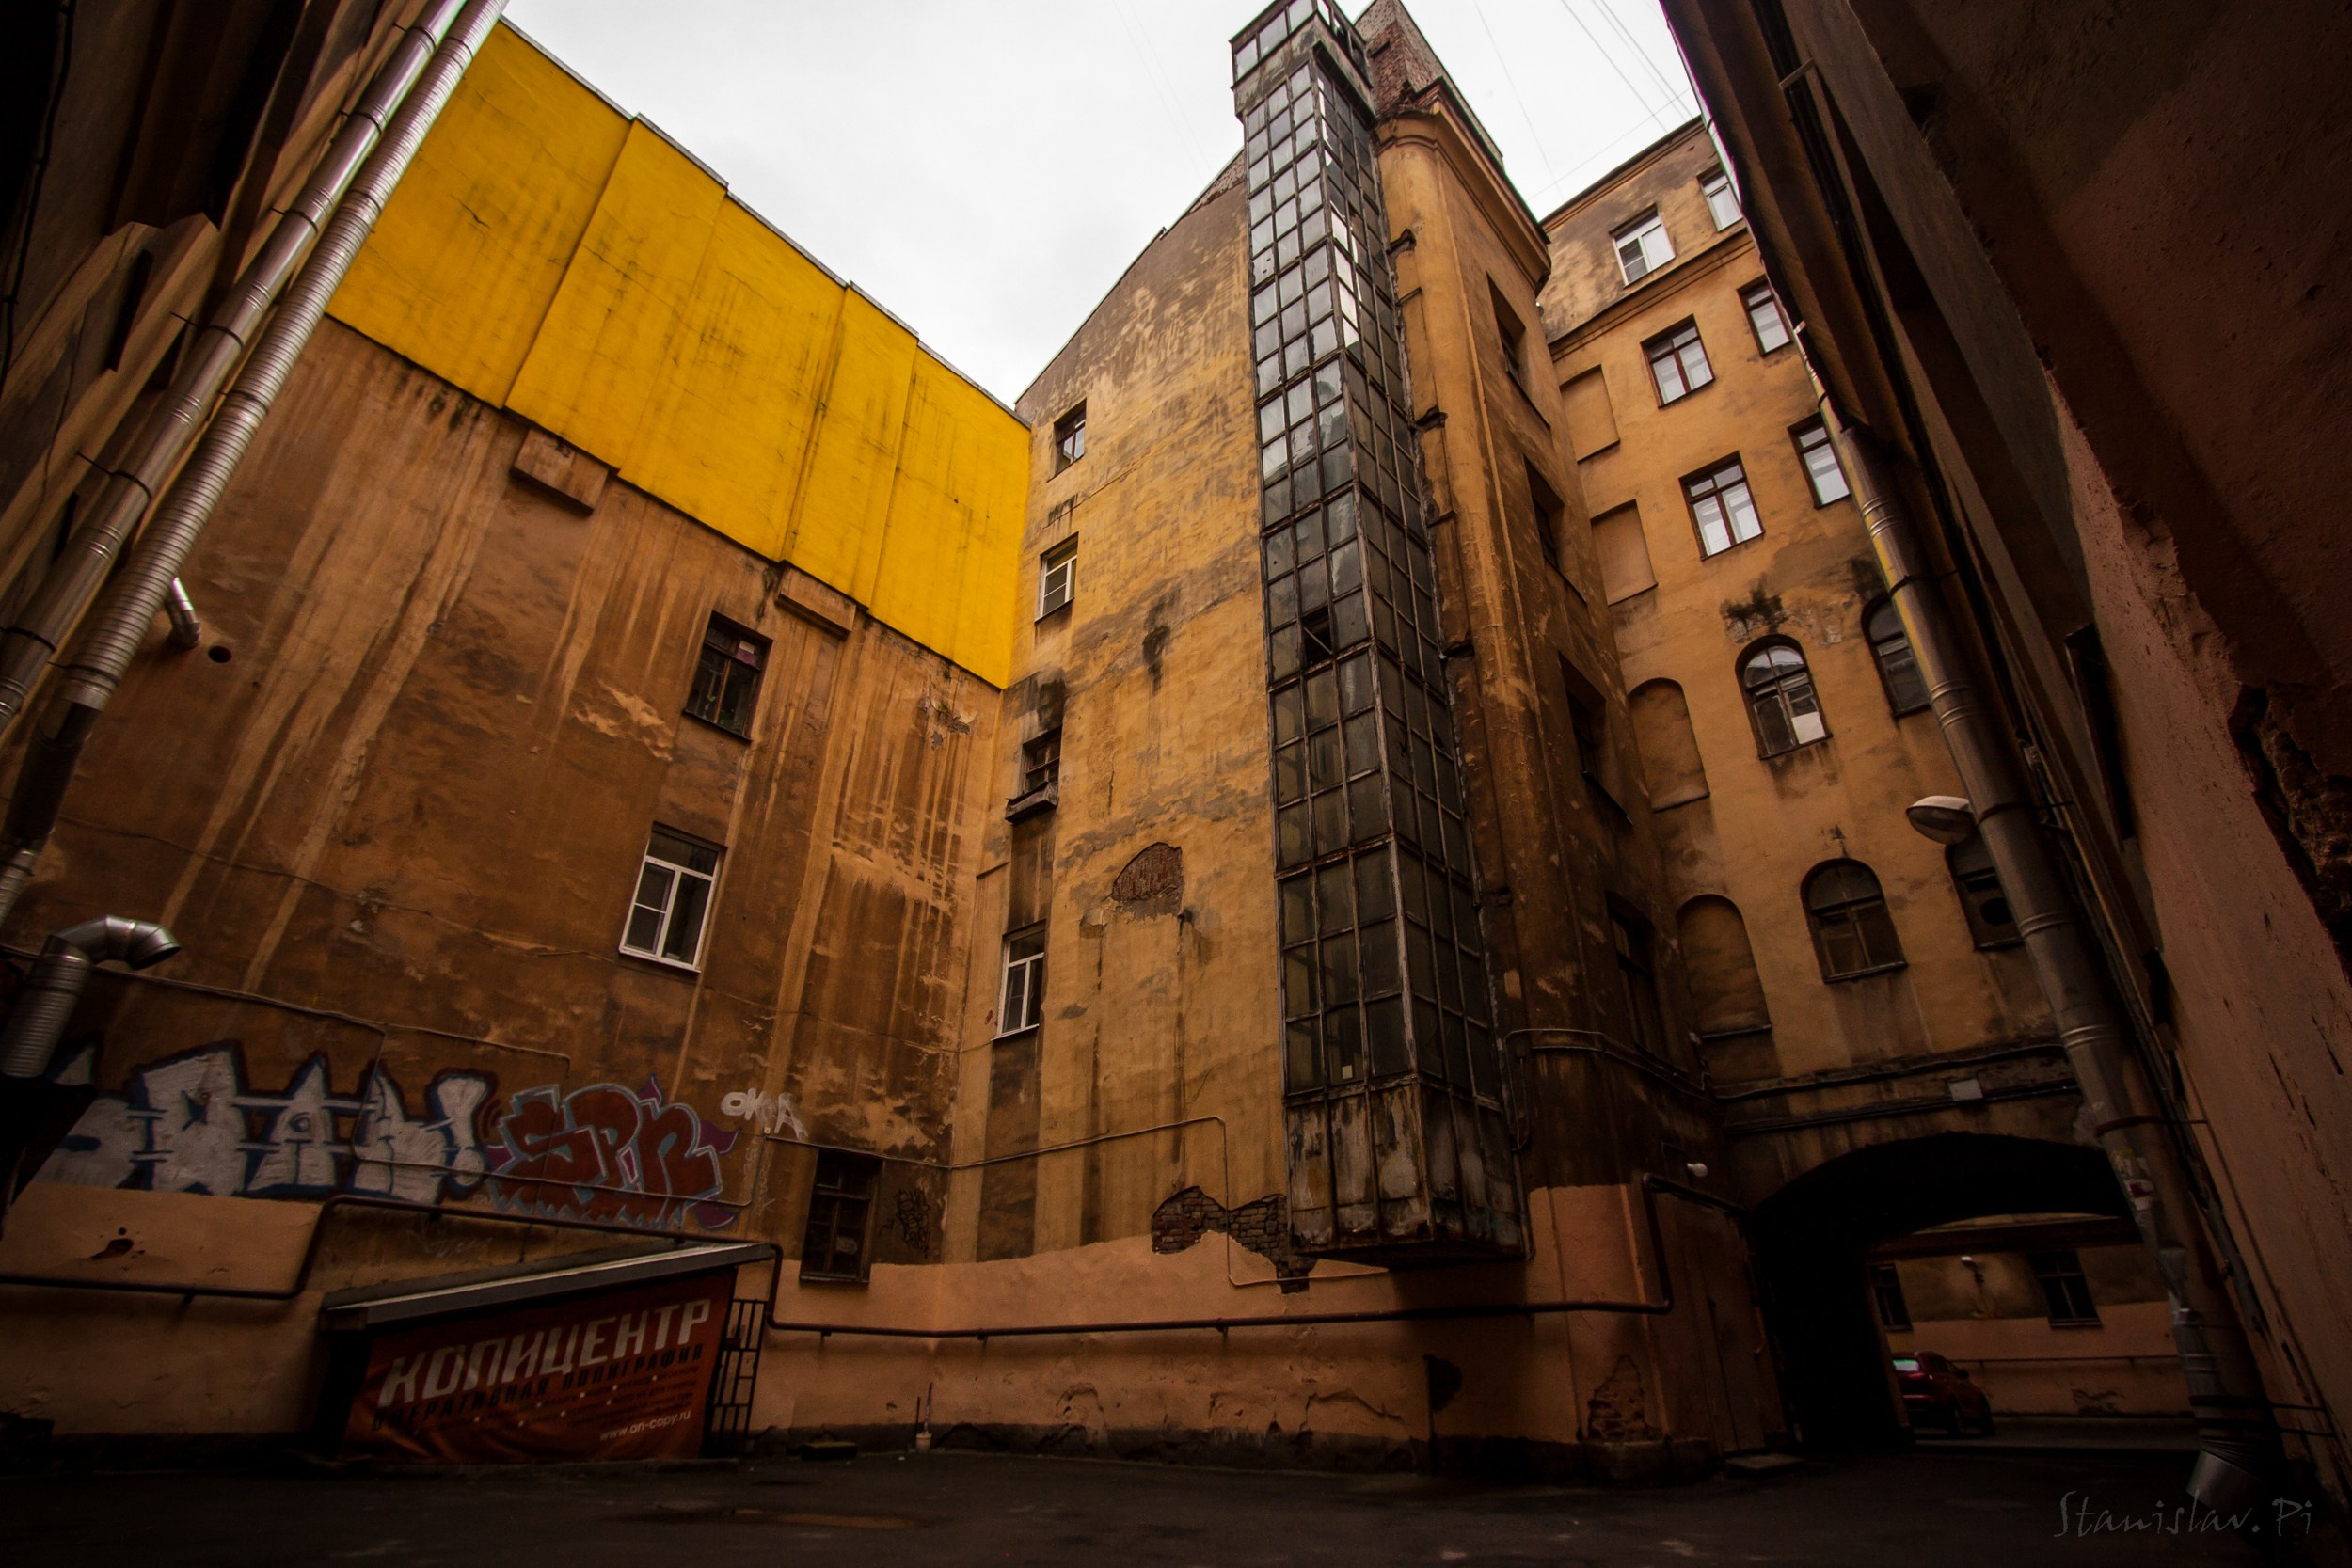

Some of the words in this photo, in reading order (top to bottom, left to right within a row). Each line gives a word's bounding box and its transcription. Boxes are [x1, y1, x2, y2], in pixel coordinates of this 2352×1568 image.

[379, 1298, 712, 1407] КОПИЦЕНТР
[562, 1344, 704, 1388] ПОЛИГРАФИЯ
[599, 1410, 691, 1441] www.on-copy.ru
